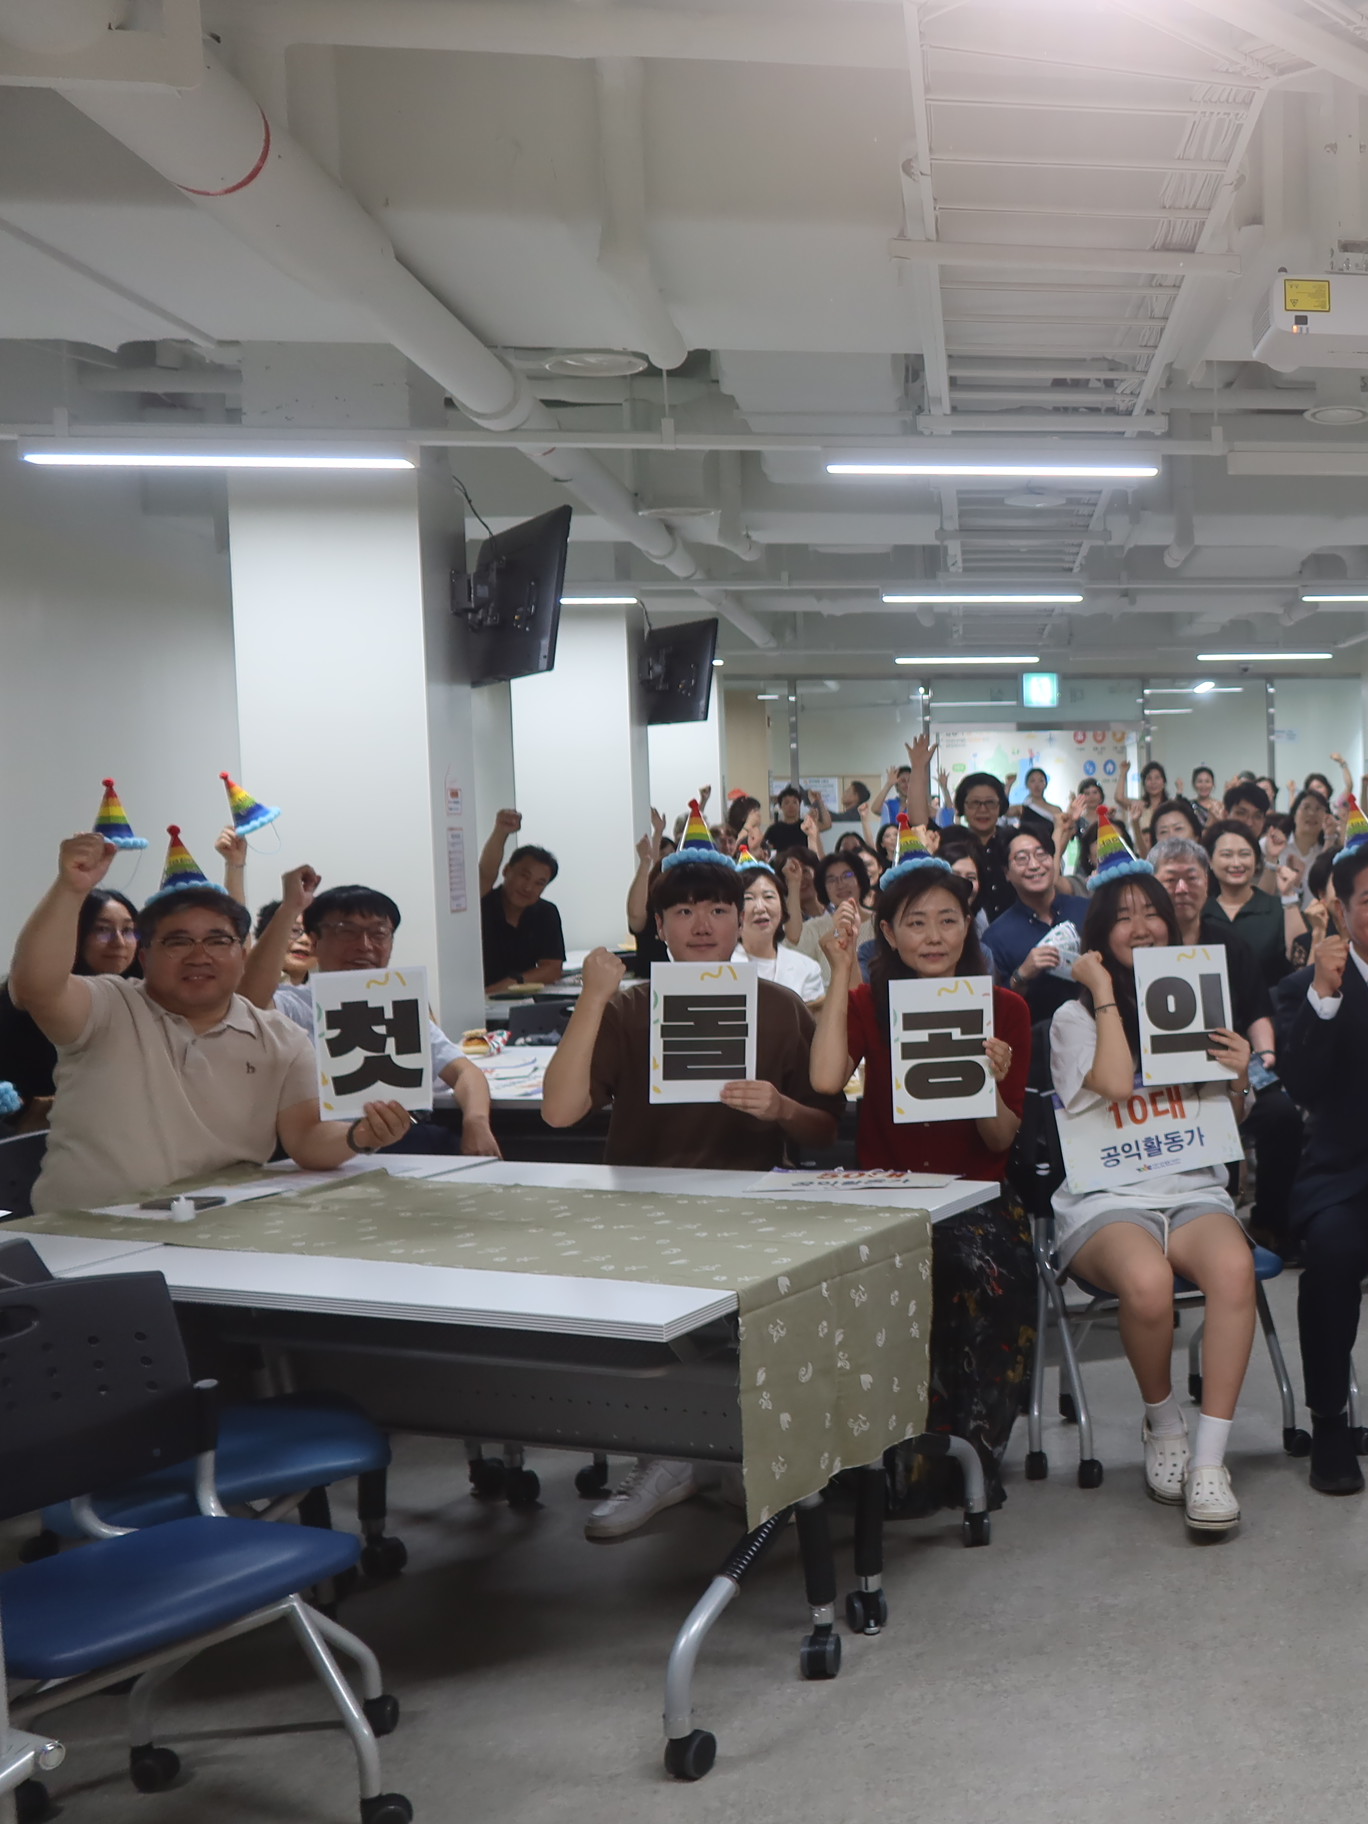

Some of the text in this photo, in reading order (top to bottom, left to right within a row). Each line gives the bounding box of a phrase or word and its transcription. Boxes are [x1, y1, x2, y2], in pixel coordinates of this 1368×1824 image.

[325, 998, 424, 1097] 첫
[660, 994, 749, 1081] 돌
[900, 1008, 988, 1100] 공
[1145, 973, 1227, 1062] 익
[1100, 1126, 1205, 1168] 공익활동가
[1107, 1086, 1187, 1129] 10대
